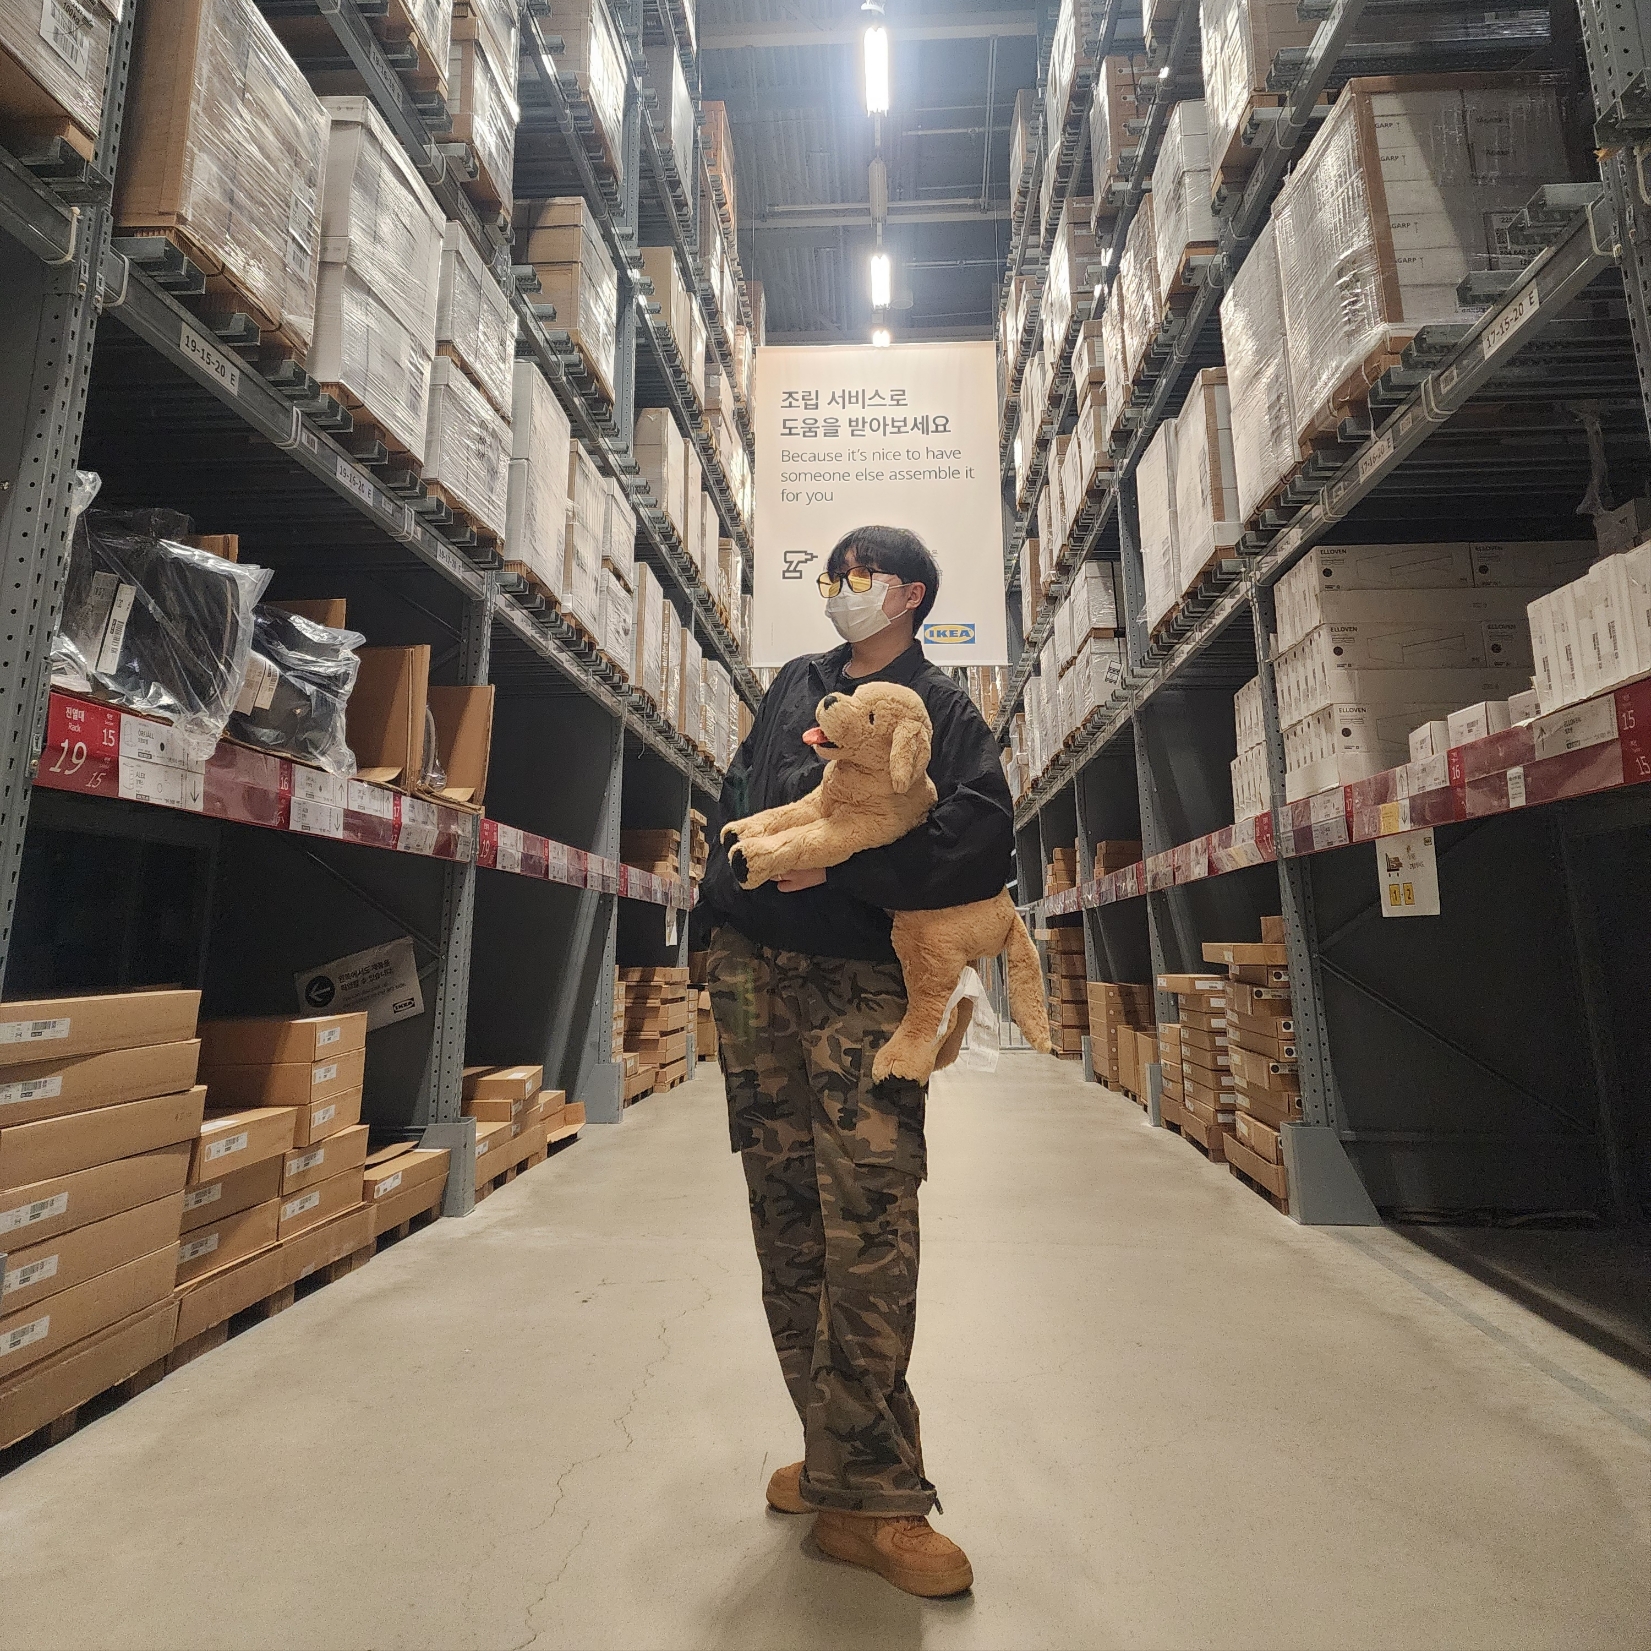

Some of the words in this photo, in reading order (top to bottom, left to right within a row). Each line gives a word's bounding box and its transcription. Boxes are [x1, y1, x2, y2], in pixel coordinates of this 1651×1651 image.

[1486, 303, 1524, 349] 17-15-20
[1528, 290, 1536, 307] E
[184, 335, 226, 378] 19-15-20
[230, 372, 236, 387] E
[780, 389, 820, 411] 조립
[827, 388, 909, 410] 서비스로
[780, 416, 842, 438] 도움을
[848, 414, 952, 438] 받아보세요
[781, 449, 843, 463] Because
[847, 448, 868, 462] it's
[872, 448, 902, 462] nice
[906, 448, 921, 461] to
[925, 446, 962, 461] have
[780, 470, 851, 483] someone
[855, 467, 885, 482] else
[888, 466, 961, 481] assemble
[965, 466, 975, 480] it
[780, 488, 802, 503] for
[805, 491, 834, 506] you
[1320, 548, 1347, 556] ELLOVEN
[68, 722, 81, 733] Rack
[1622, 709, 1636, 731] 15
[101, 727, 116, 748] 15
[49, 738, 88, 775] 19
[1635, 755, 1651, 776] 15
[85, 771, 107, 789] 15
[1451, 764, 1461, 781] 16
[280, 776, 289, 791] 16
